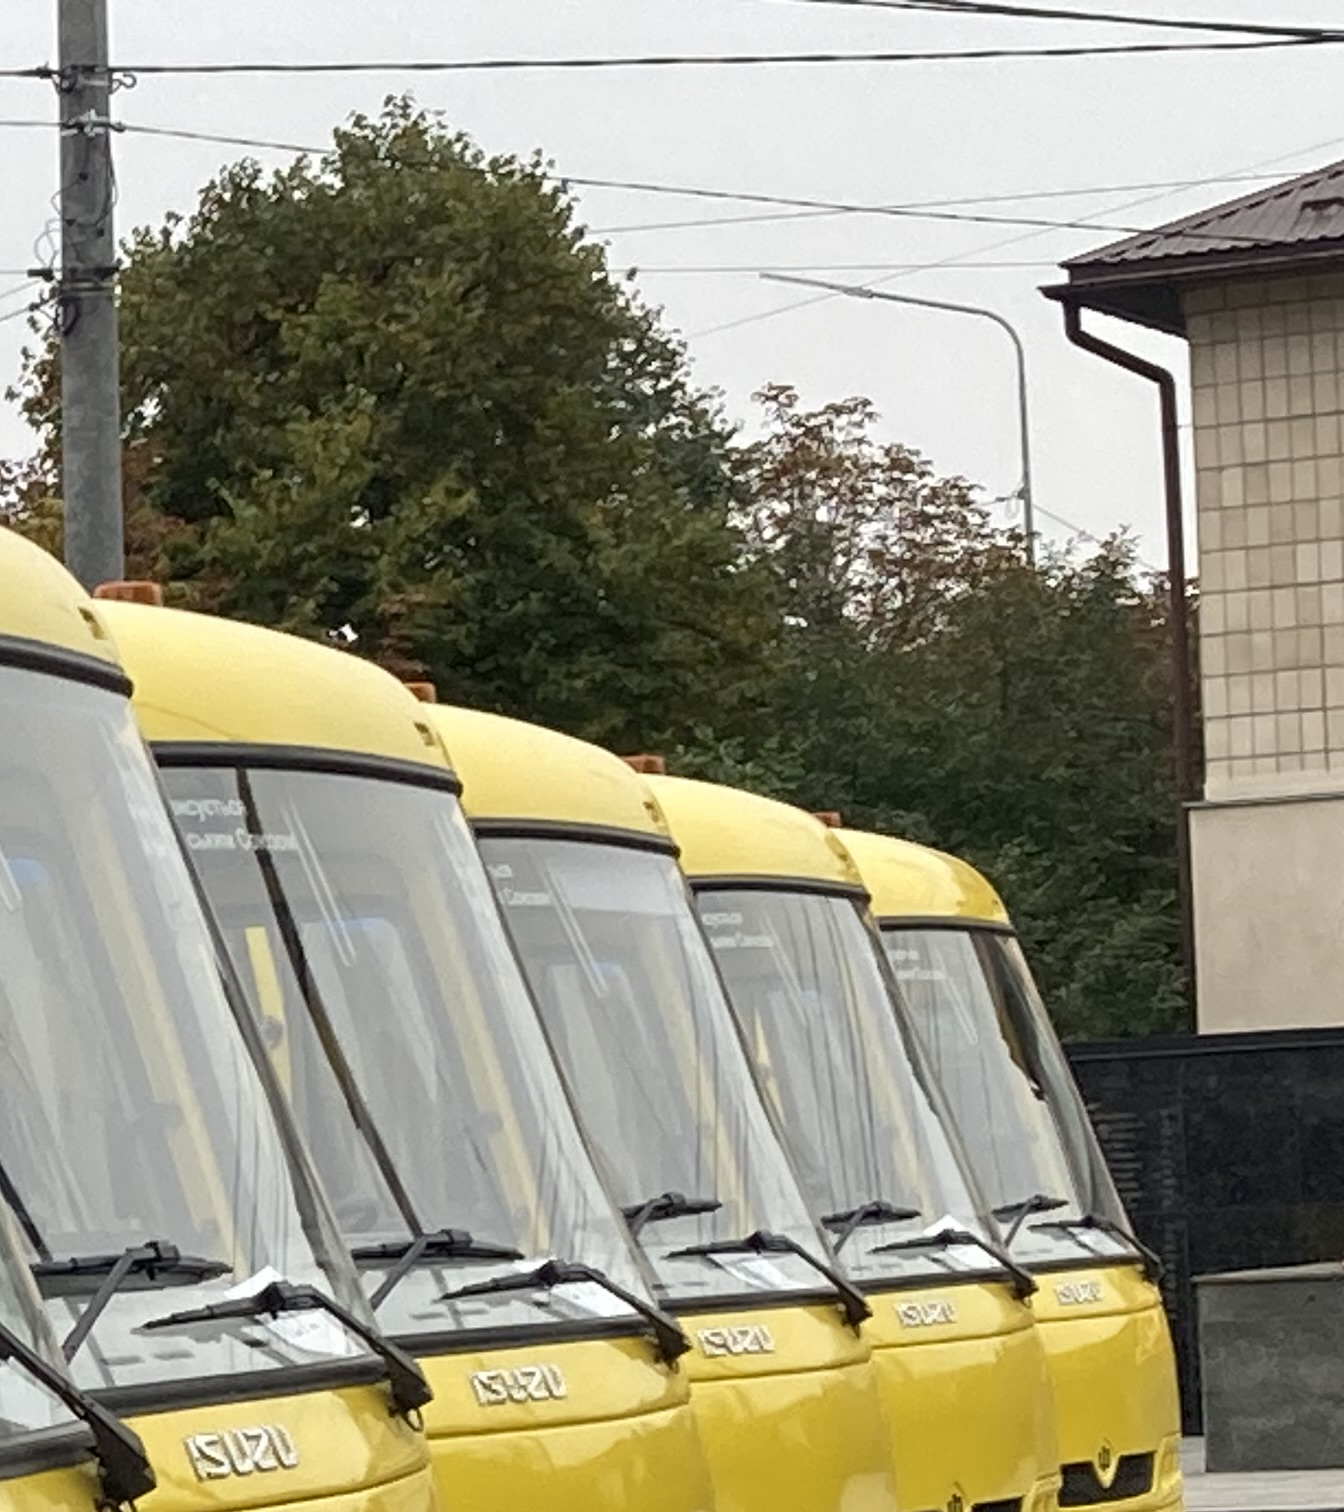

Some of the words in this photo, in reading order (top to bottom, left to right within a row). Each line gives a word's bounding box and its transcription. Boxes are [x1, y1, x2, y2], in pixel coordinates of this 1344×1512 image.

[696, 1324, 775, 1358] ISUZU
[469, 1362, 568, 1407] ISUZU
[183, 1423, 300, 1482] ISUZU
